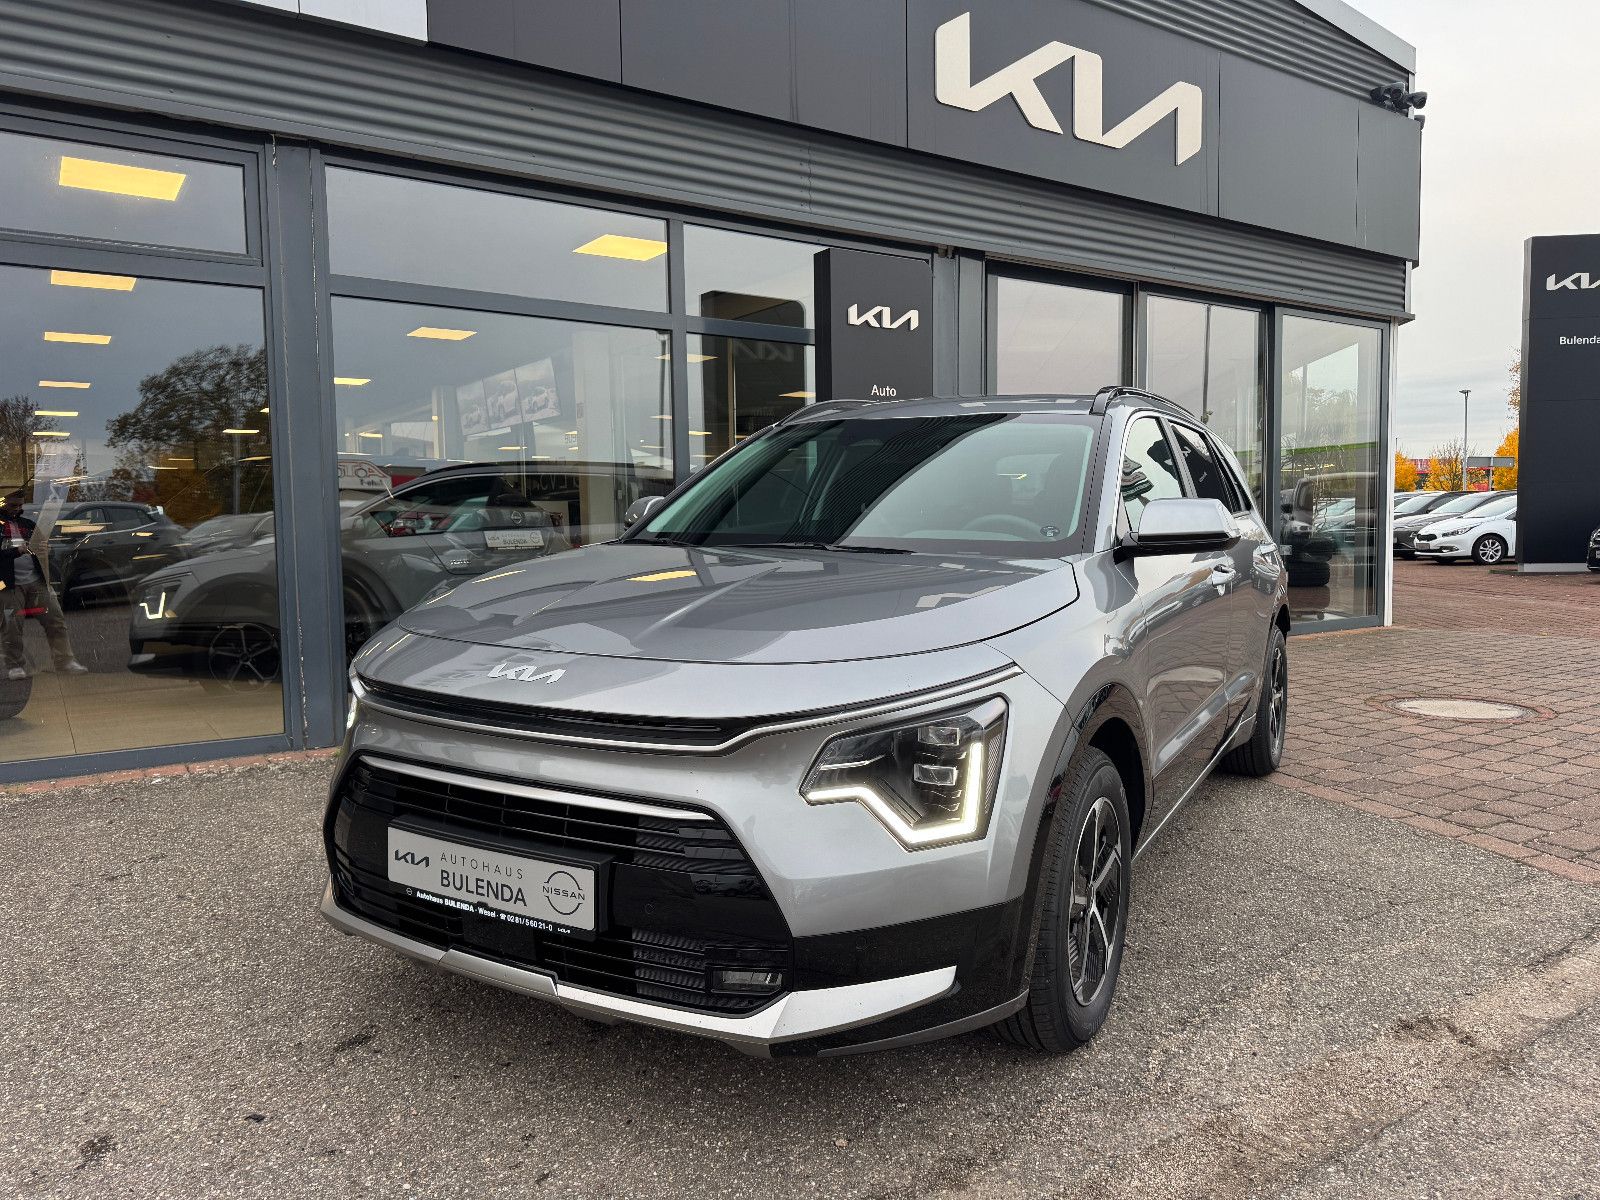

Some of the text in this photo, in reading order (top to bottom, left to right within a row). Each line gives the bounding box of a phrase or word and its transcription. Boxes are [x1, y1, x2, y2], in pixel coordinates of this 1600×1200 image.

[935, 12, 1202, 166] KIA
[847, 303, 919, 331] KIA
[1559, 335, 1600, 345] Bulenda
[870, 385, 897, 397] Auto
[487, 662, 567, 684] KIA
[394, 849, 430, 868] KIA
[440, 852, 523, 880] AUTOHAUS
[440, 869, 528, 907] BULENDA
[542, 885, 586, 901] NISSAN
[416, 890, 444, 905] Autohaus
[444, 898, 475, 913] BULENDA
[477, 906, 496, 918] Wesel
